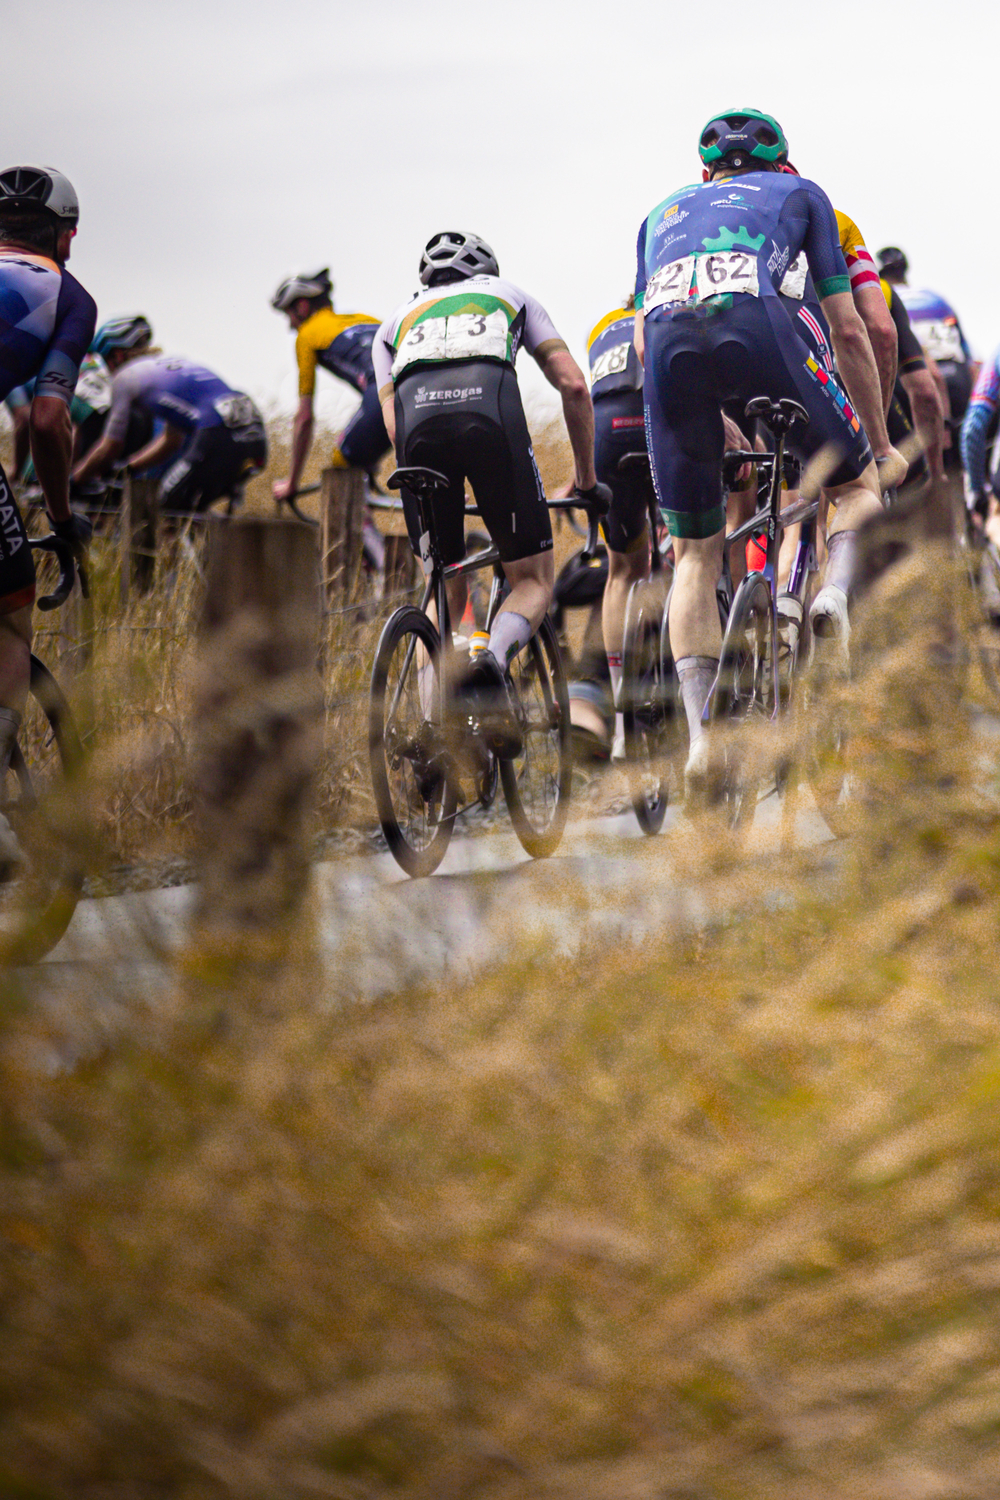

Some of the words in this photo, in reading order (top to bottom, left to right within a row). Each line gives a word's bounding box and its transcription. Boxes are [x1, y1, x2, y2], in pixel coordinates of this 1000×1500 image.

[704, 254, 750, 285] 62
[662, 299, 694, 311] KRE
[406, 325, 425, 346] 3
[467, 315, 487, 337] 3
[428, 386, 483, 401] ZEROgas
